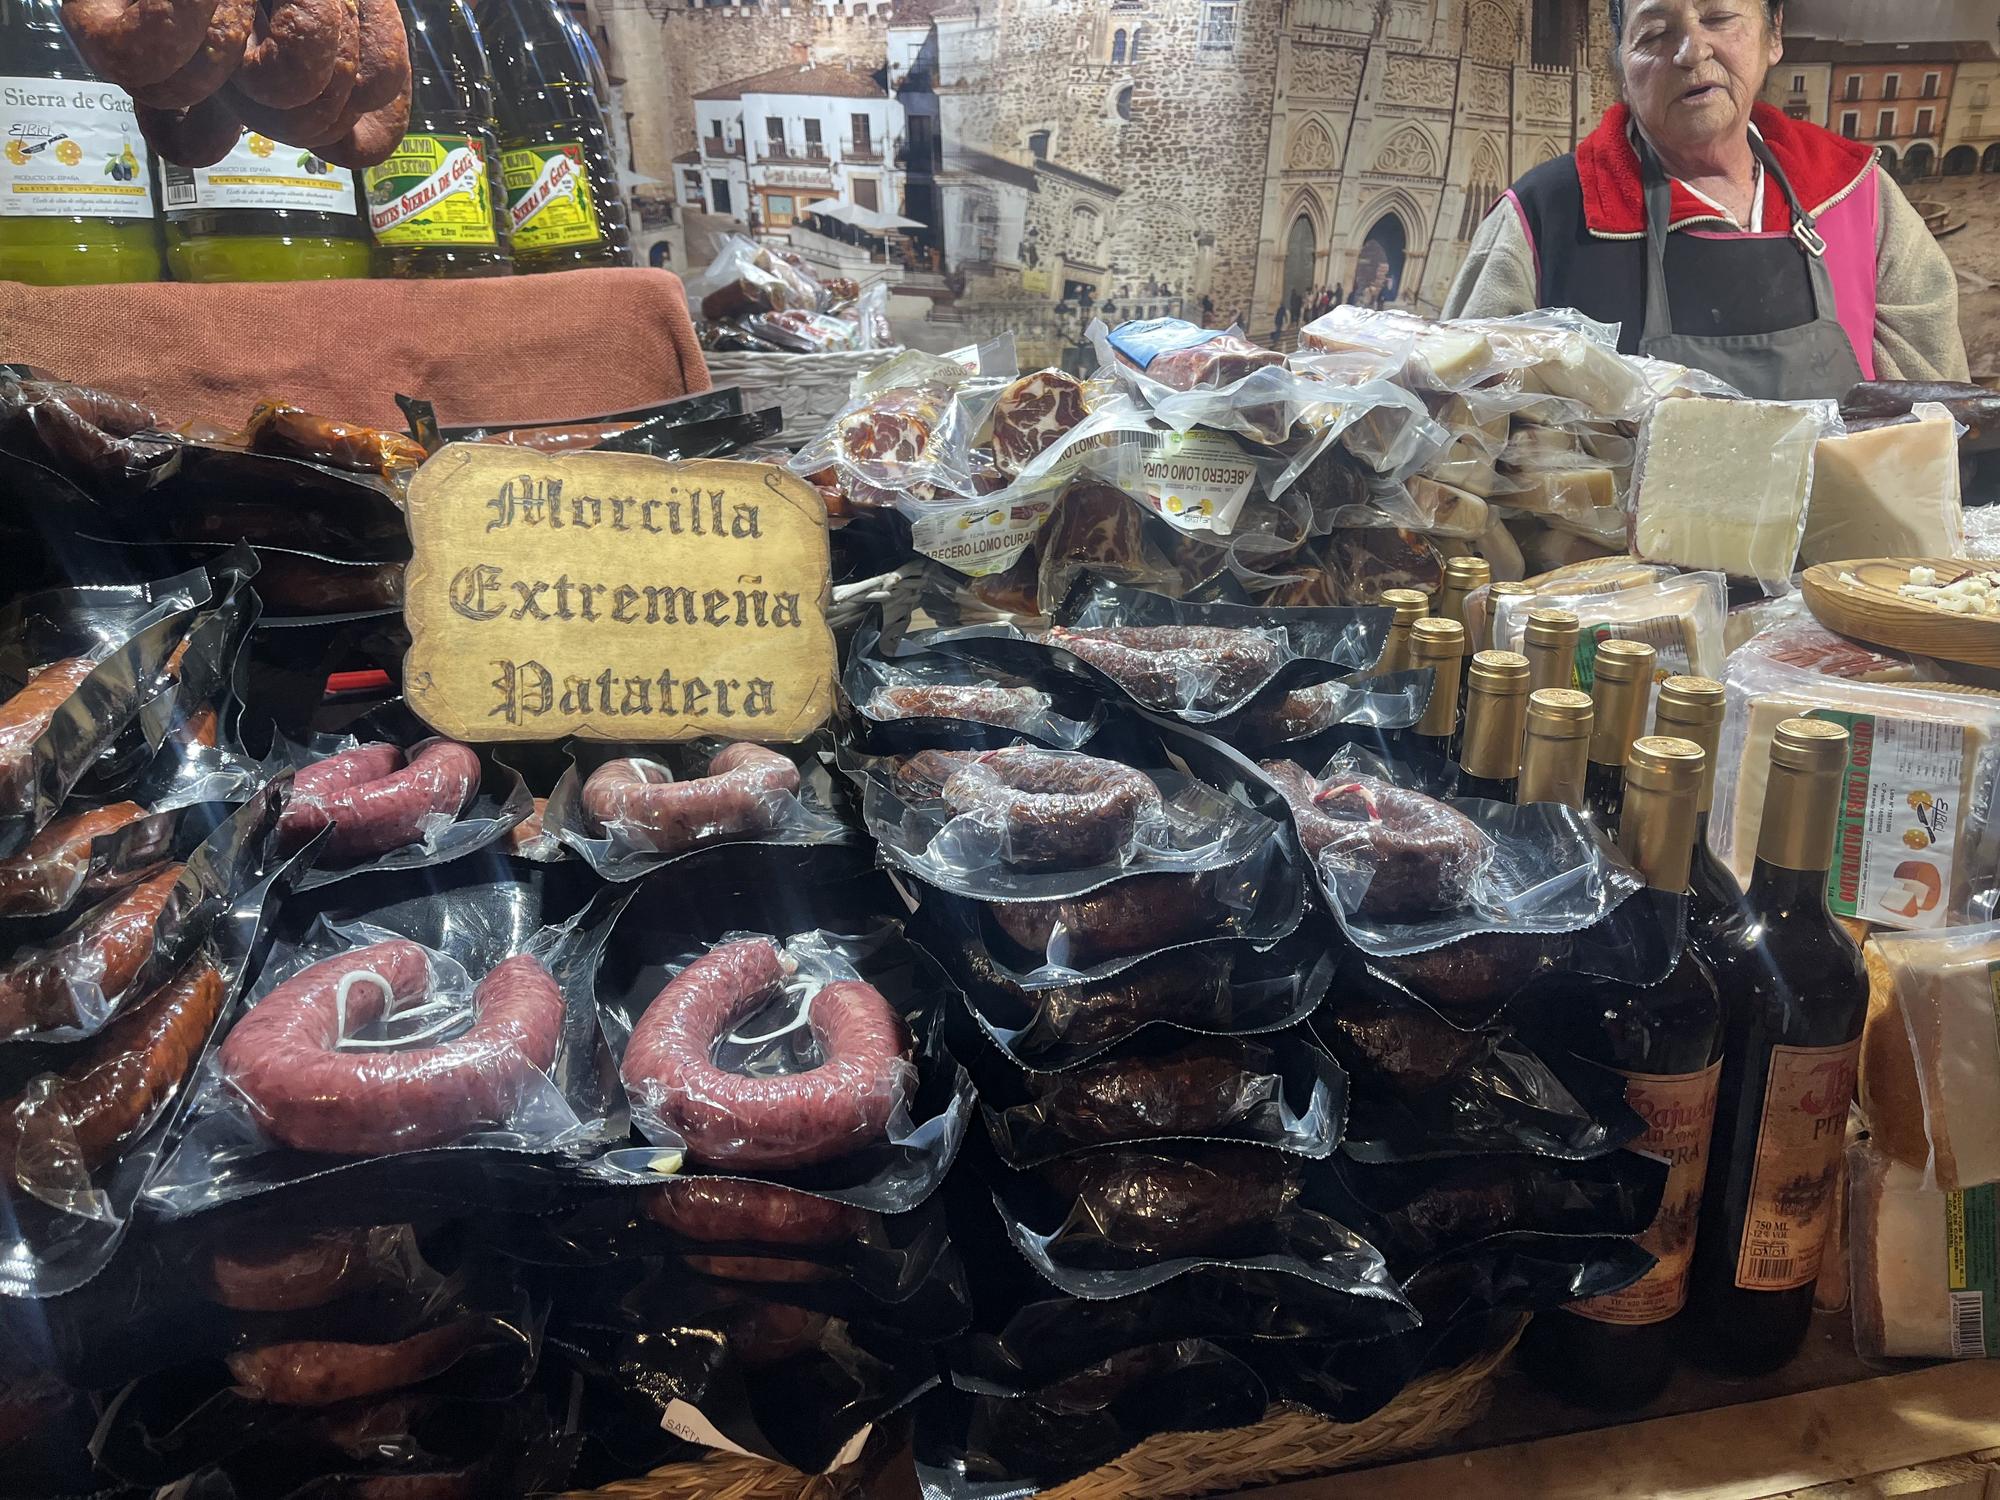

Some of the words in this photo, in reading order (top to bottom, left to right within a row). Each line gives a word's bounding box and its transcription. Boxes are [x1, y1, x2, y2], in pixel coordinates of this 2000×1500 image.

[4, 88, 66, 107] Sierra
[72, 92, 95, 109] de
[100, 93, 135, 113] Gata
[401, 184, 438, 216] SIERRA
[439, 173, 451, 192] DE
[1171, 465, 1200, 482] LOMO
[1202, 465, 1251, 485] ABECERO
[486, 475, 764, 539] Morcilla
[925, 543, 972, 560] ABECERO
[974, 536, 1002, 554] LOMO
[449, 563, 800, 628] Extremeña
[488, 659, 777, 727] Patatera
[1851, 722, 1873, 767] QUESO
[1845, 771, 1868, 818] CABRA
[1839, 823, 1863, 902] MADURADO
[1755, 1220, 1772, 1231] 750
[1774, 1221, 1790, 1232] ML
